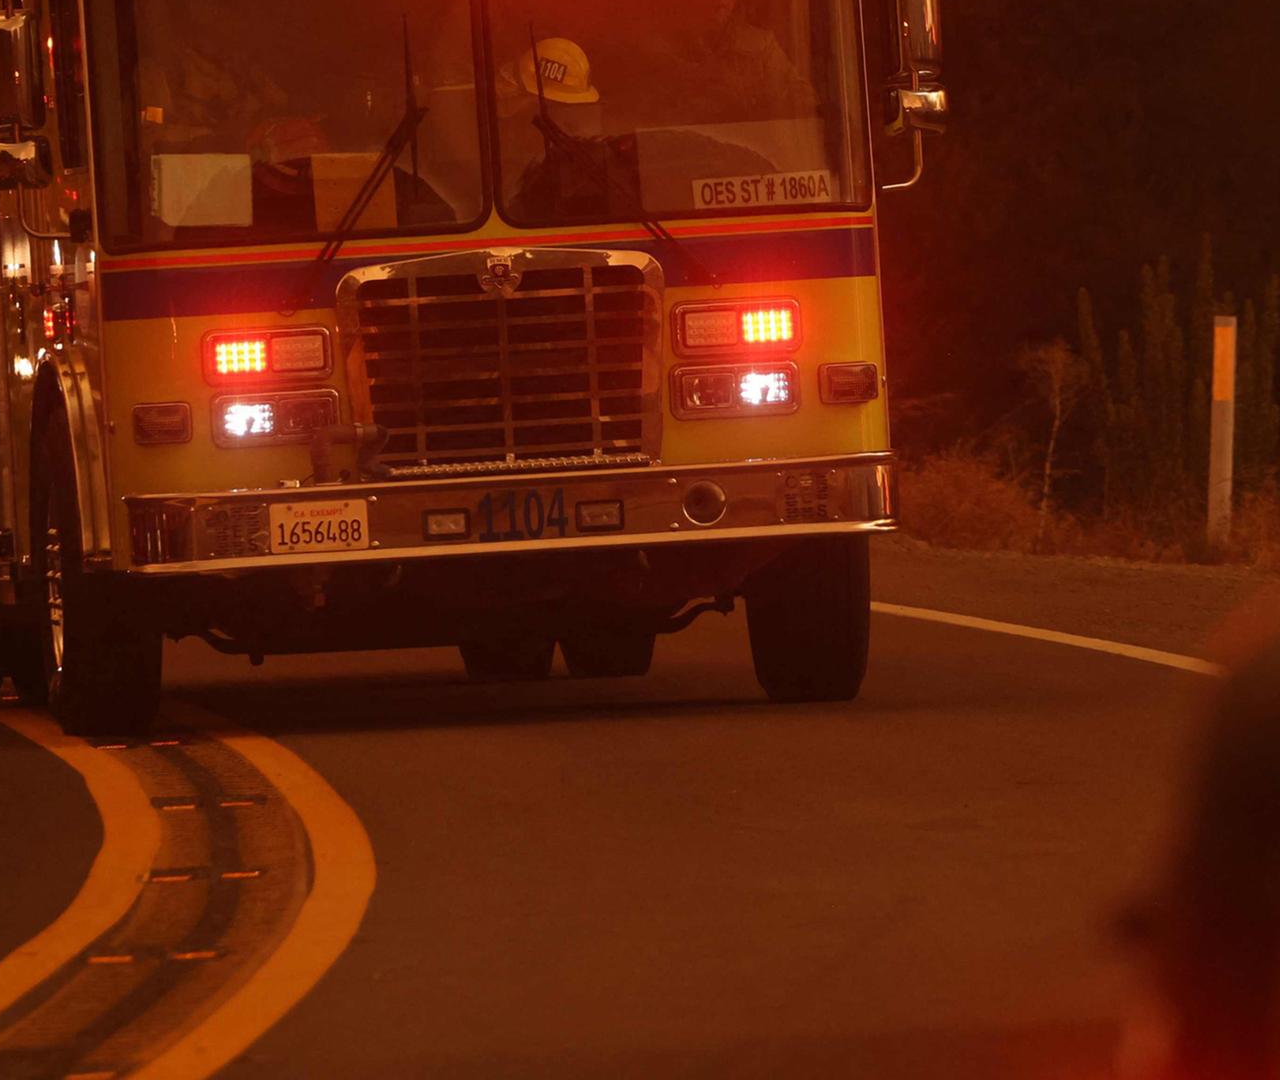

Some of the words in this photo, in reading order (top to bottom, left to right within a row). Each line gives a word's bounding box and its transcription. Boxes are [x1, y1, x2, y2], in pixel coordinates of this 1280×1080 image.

[701, 181, 736, 205] OES
[740, 178, 761, 203] ST
[765, 177, 776, 201] #
[780, 174, 830, 200] 1860A
[477, 487, 570, 543] 1104
[278, 519, 362, 546] 1656488
